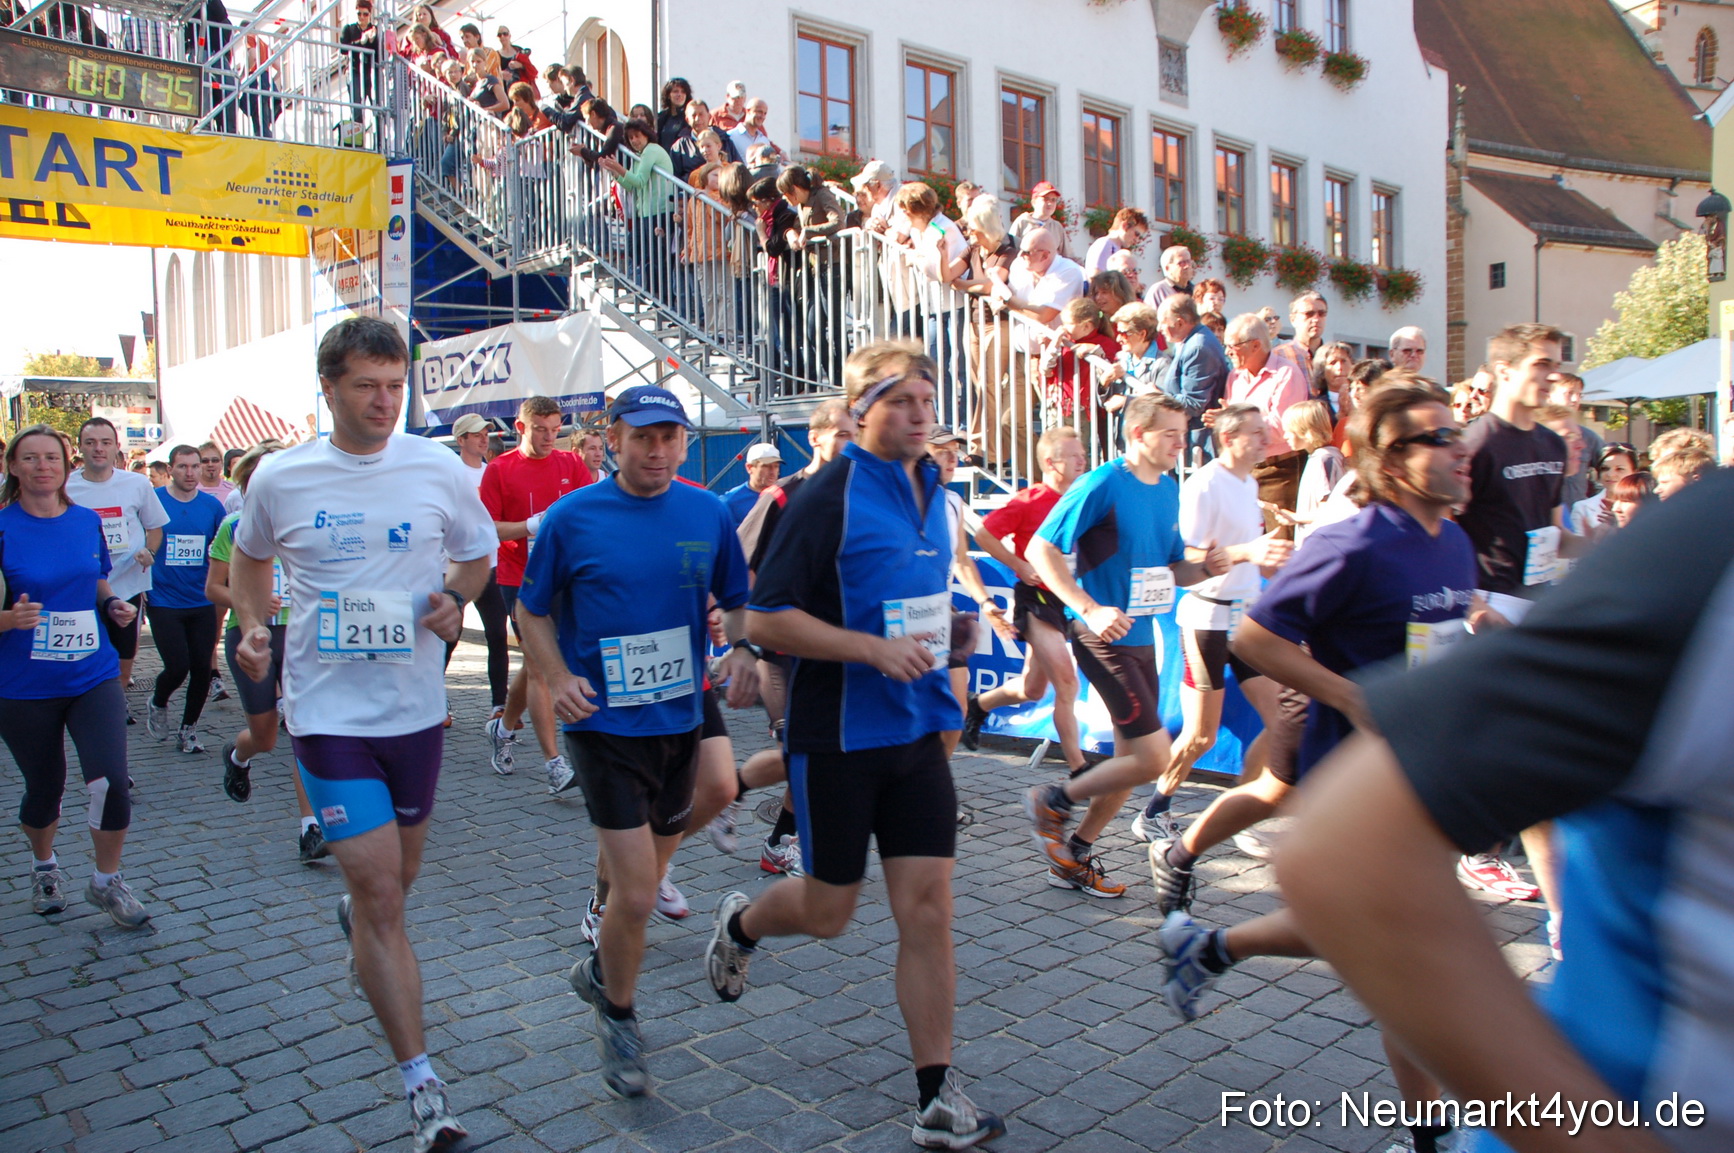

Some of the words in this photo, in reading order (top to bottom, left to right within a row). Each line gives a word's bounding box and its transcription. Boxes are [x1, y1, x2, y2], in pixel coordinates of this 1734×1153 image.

[22, 36, 84, 57] Elektronische
[87, 50, 192, 75] Sportstätteneinrichtungen
[225, 181, 298, 199] Neumarkter
[300, 189, 354, 204] Stadtlauf
[178, 548, 202, 558] 2910
[344, 597, 375, 612] Erich
[53, 616, 77, 627] Doris
[53, 632, 95, 648] 2715
[346, 624, 406, 645] 2118
[626, 639, 660, 657] Frank
[631, 657, 686, 686] 2127
